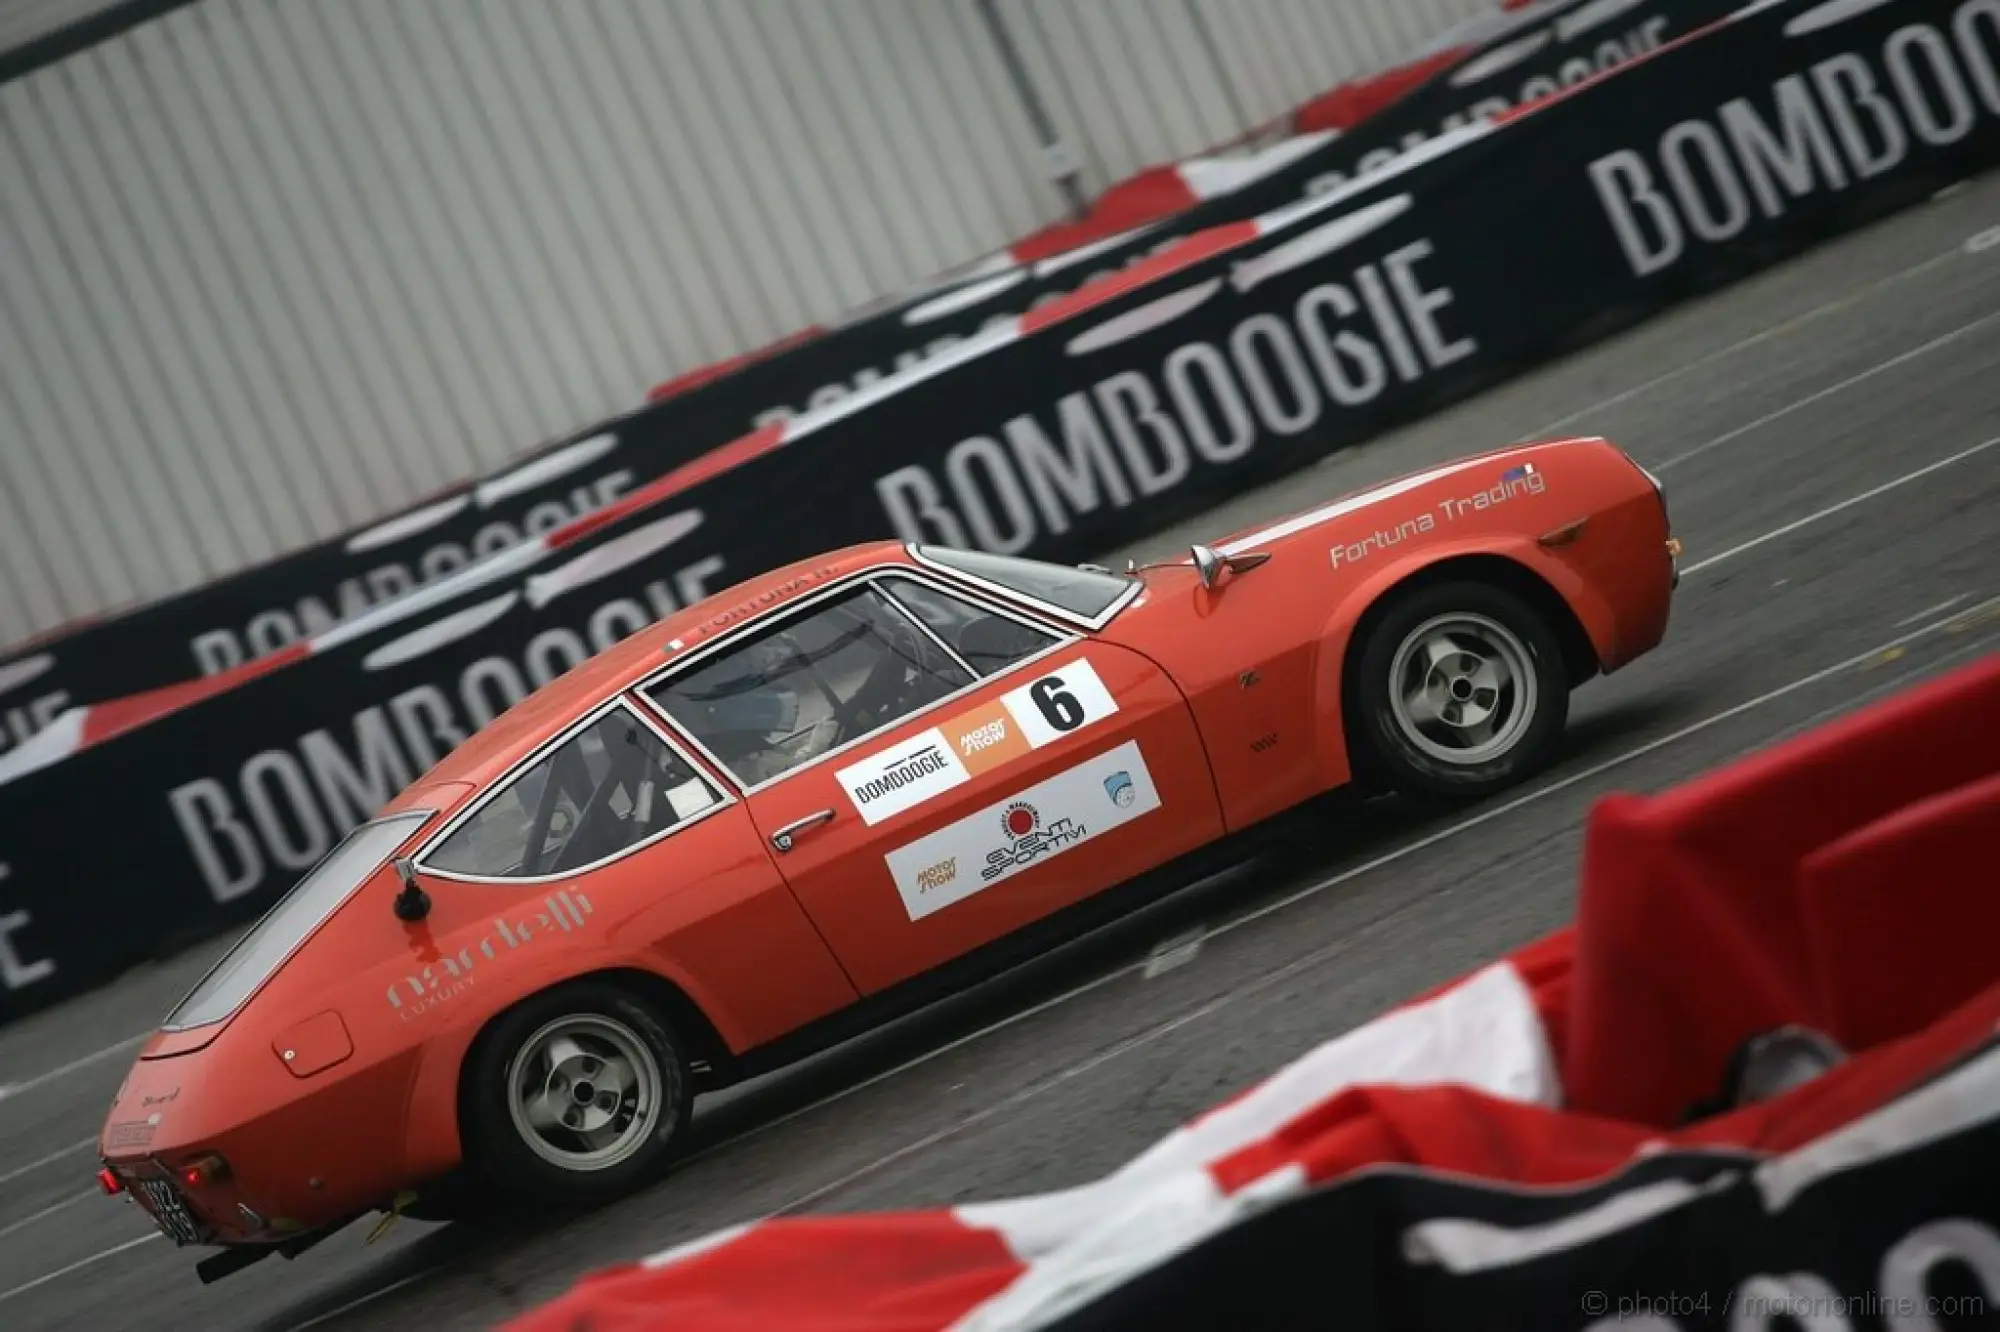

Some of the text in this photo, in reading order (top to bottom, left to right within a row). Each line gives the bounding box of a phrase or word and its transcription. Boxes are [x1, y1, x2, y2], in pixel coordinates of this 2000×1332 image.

[875, 239, 1477, 558] BOMBOOGIE
[1330, 471, 1546, 570] Fortuna Trading
[1029, 675, 1086, 732] 6
